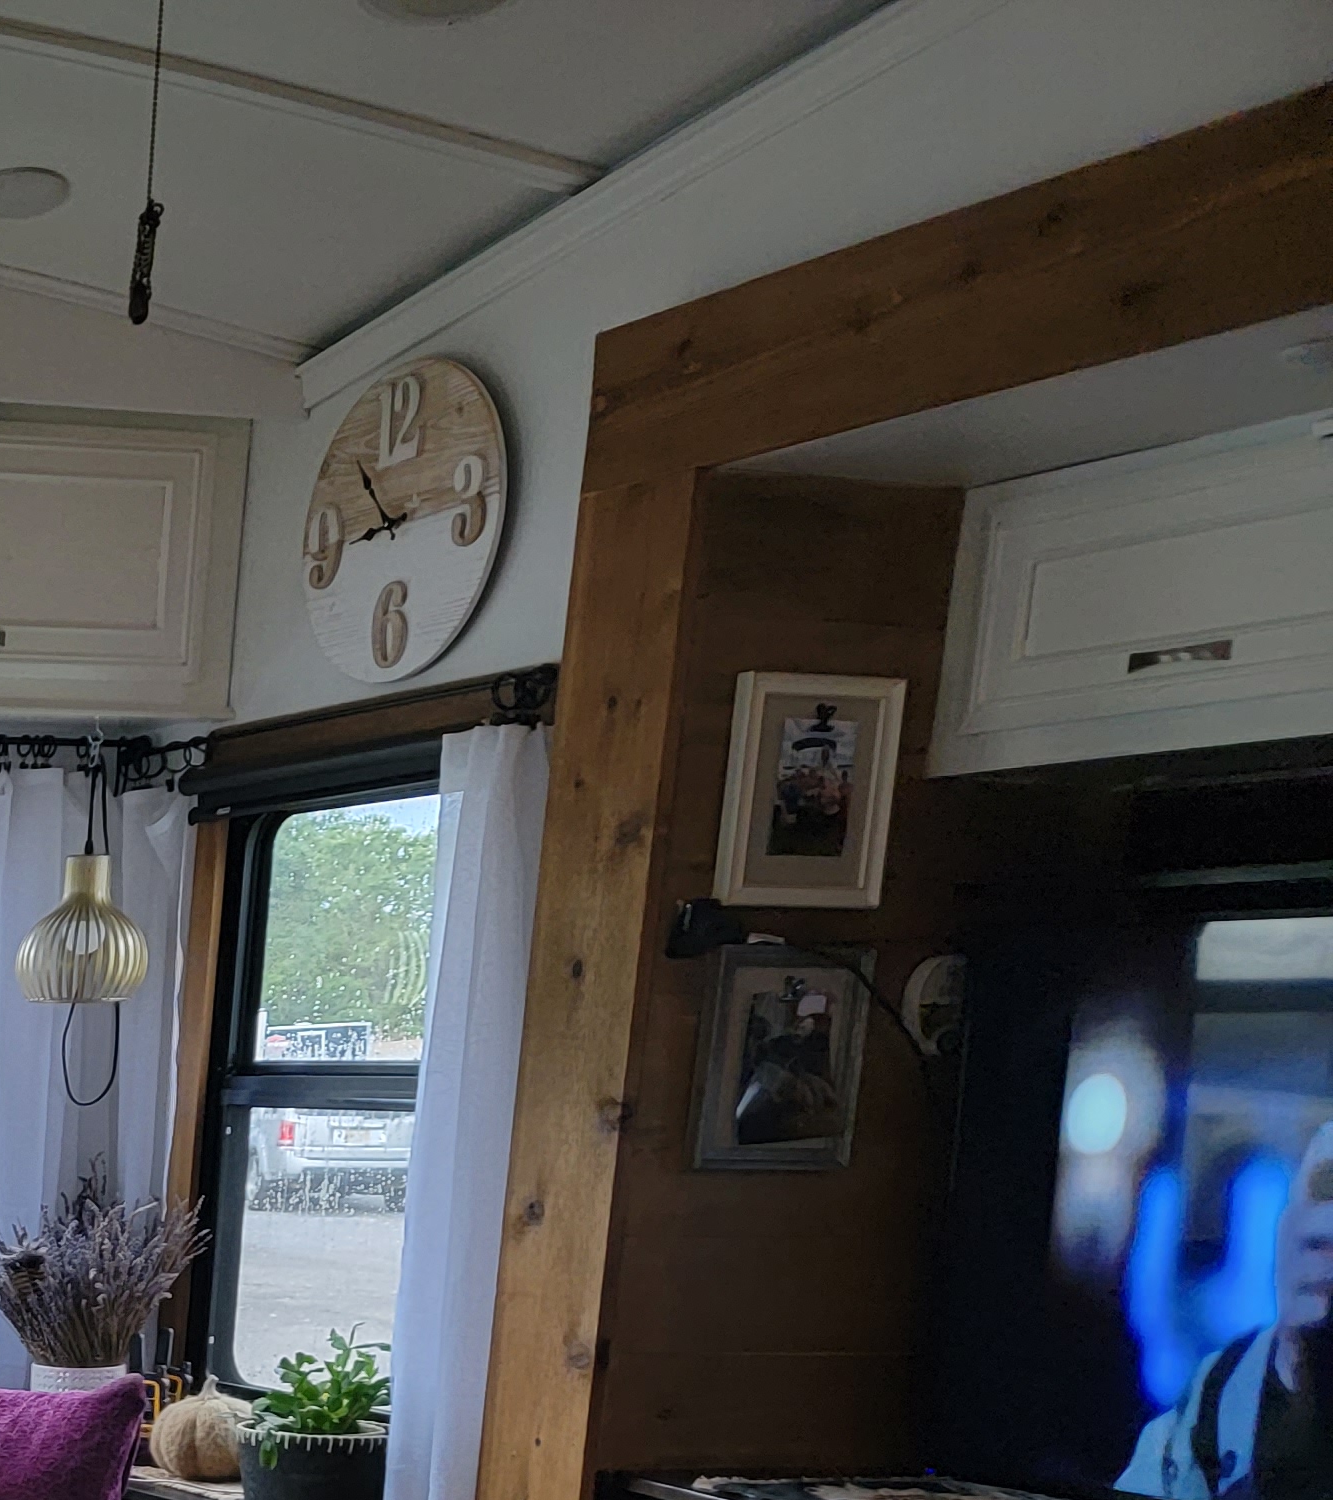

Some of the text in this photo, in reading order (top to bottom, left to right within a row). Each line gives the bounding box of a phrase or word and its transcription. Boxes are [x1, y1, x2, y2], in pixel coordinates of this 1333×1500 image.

[378, 375, 424, 470] 12
[451, 455, 487, 547] 3
[307, 504, 344, 590] 9
[371, 580, 409, 668] 6
